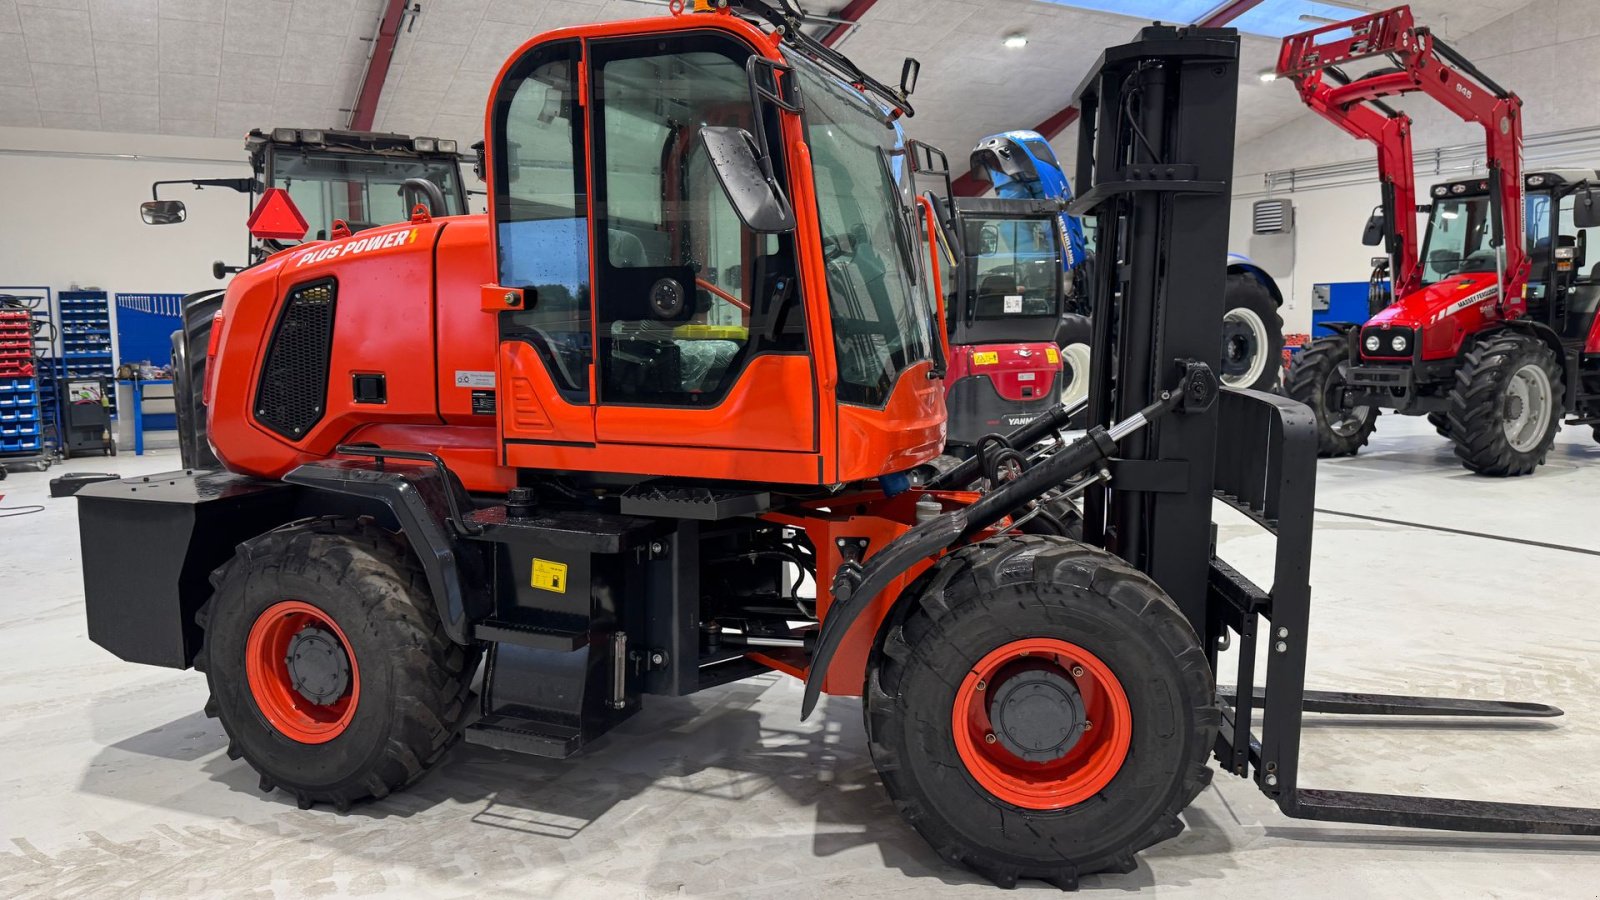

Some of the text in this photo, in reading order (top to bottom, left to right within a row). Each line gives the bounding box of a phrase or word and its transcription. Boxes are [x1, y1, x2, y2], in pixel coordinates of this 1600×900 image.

[1456, 83, 1473, 100] 945
[296, 230, 411, 267] PLUS POWER
[1058, 215, 1075, 265] NEW HOLLAND
[1457, 296, 1477, 308] MASSEY
[1008, 416, 1038, 426] YANM
